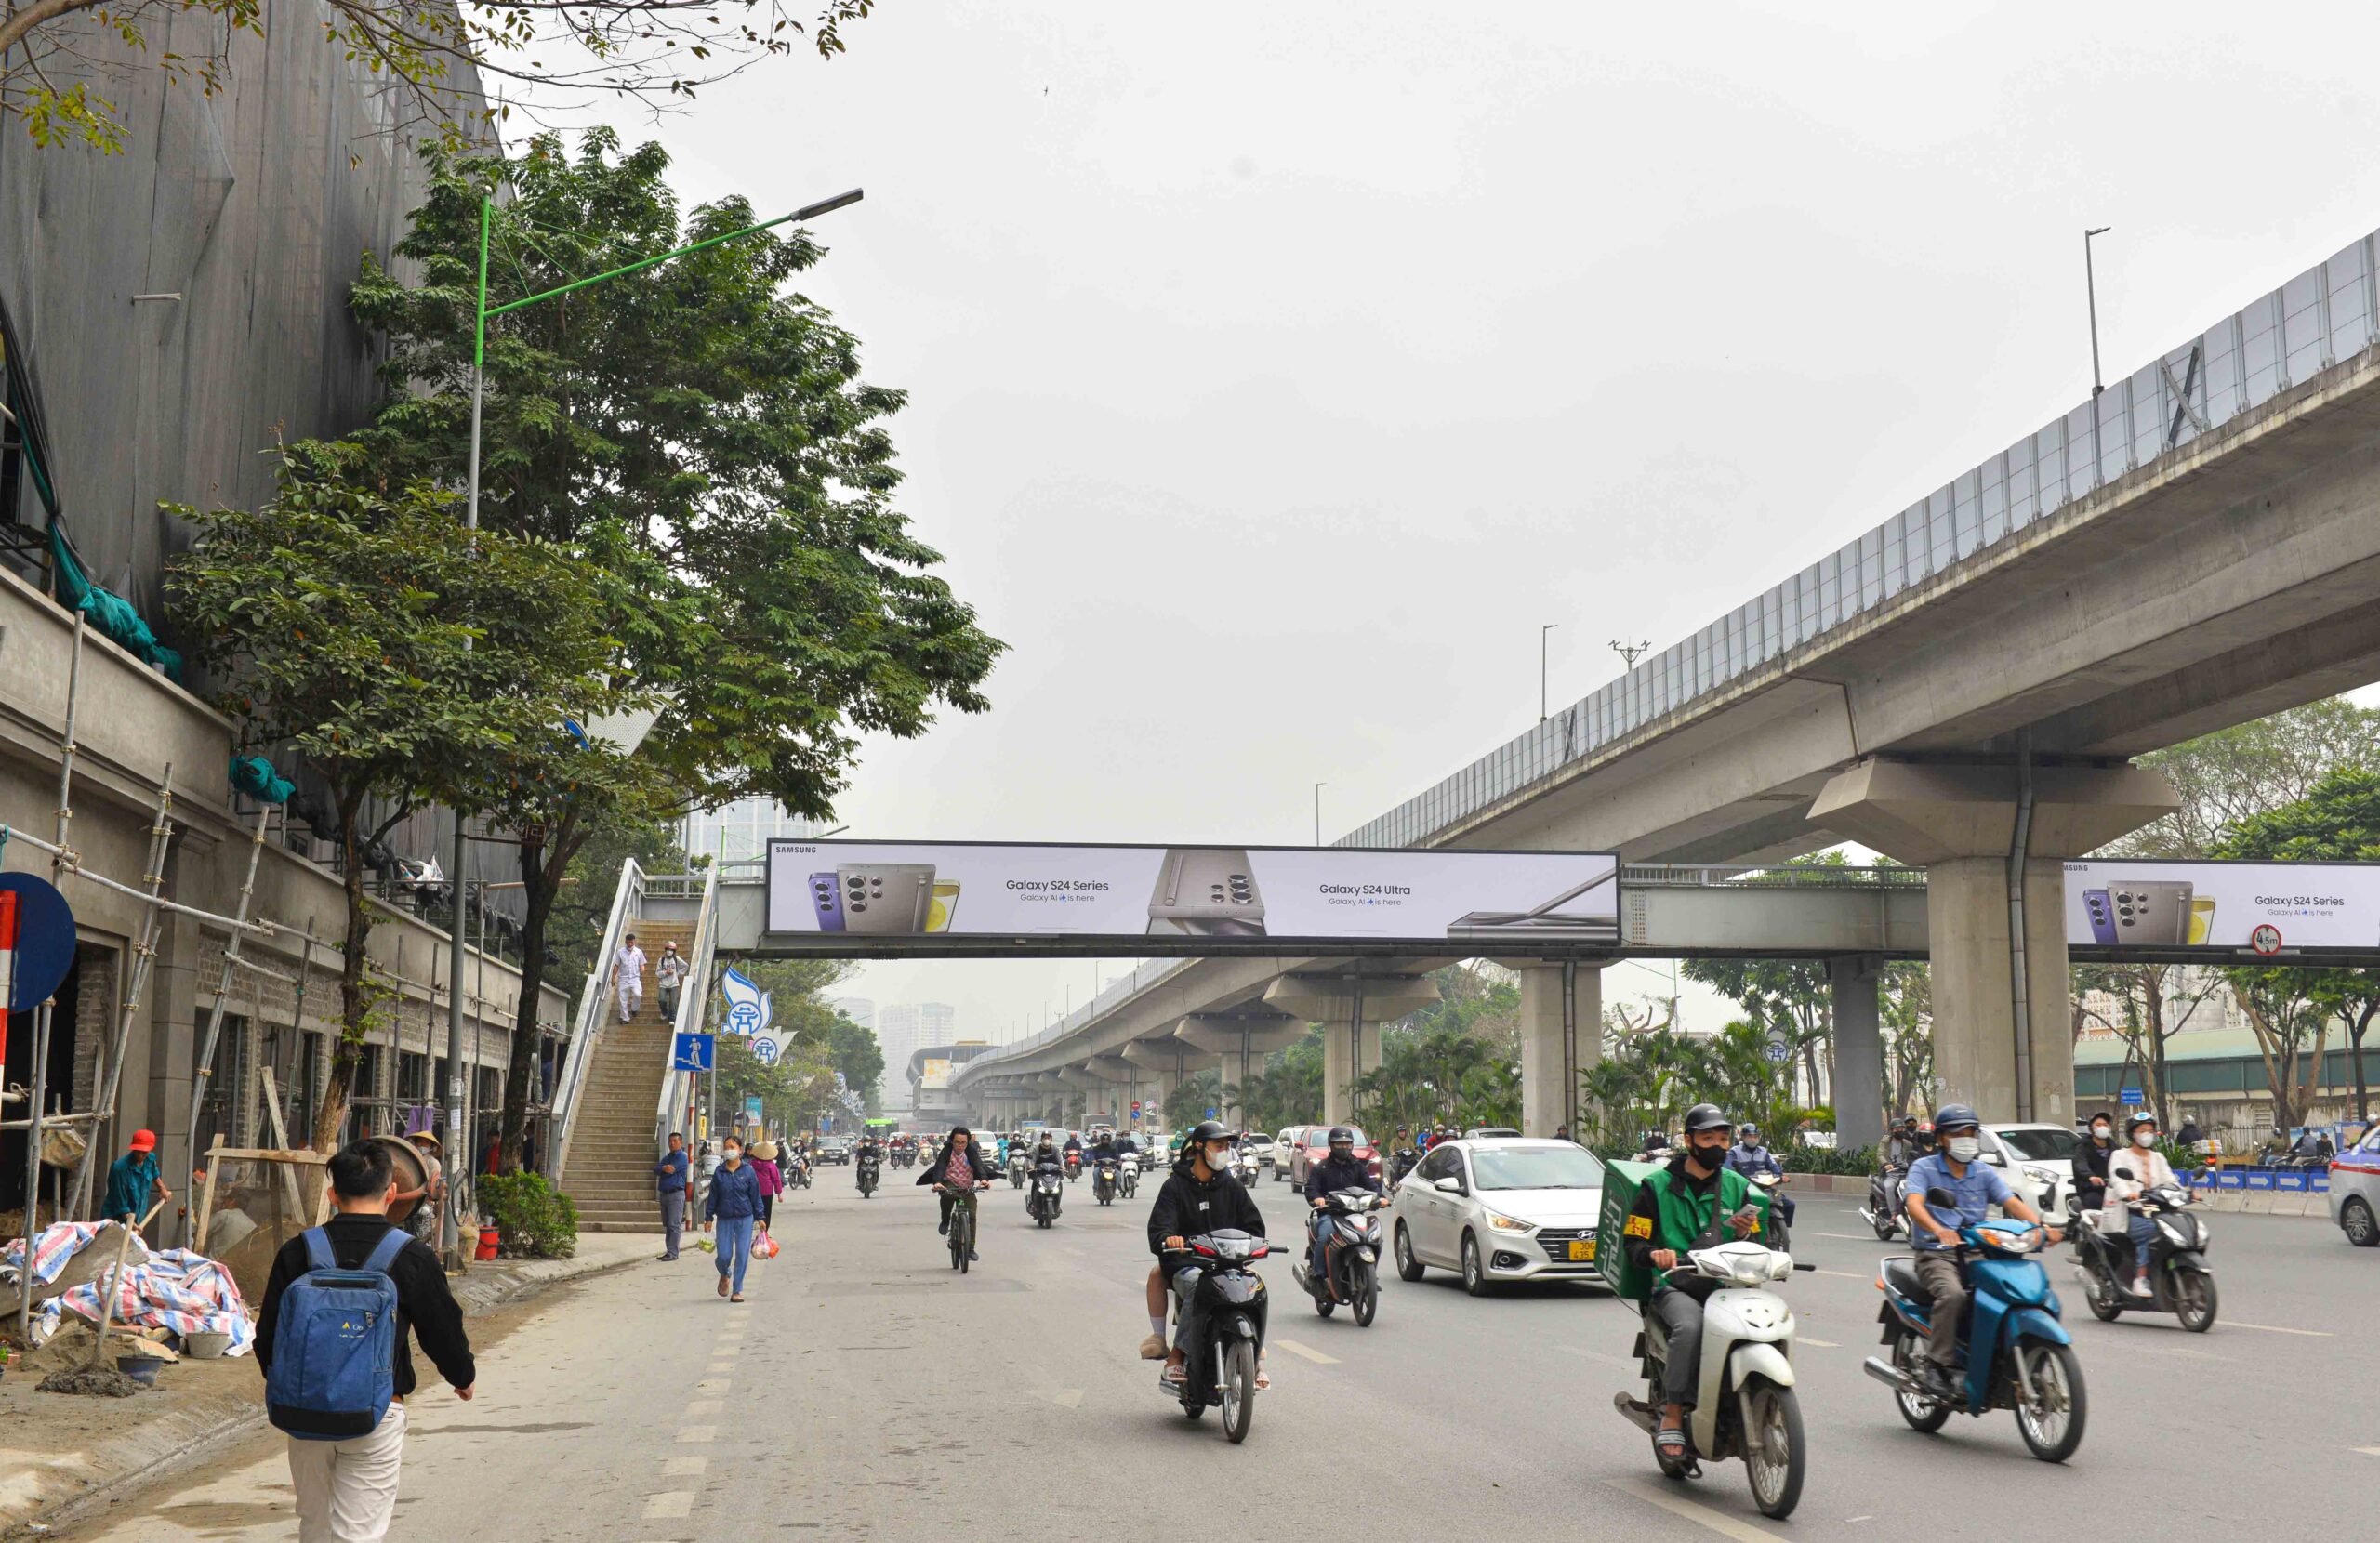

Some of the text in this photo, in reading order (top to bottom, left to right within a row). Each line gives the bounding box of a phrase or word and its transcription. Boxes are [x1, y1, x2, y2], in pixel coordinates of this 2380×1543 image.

[1006, 879, 1109, 891] Galaxy S24 Series
[1319, 884, 1411, 896] Galaxy S24 Ultra
[1020, 893, 1049, 903] Galaxy
[1067, 893, 1074, 902] is
[1076, 893, 1095, 902] here
[1329, 898, 1356, 906] Galaxy
[1382, 898, 1402, 906] here
[2254, 896, 2345, 907] Galaxy S24 Series
[2268, 909, 2293, 917] Galaxy
